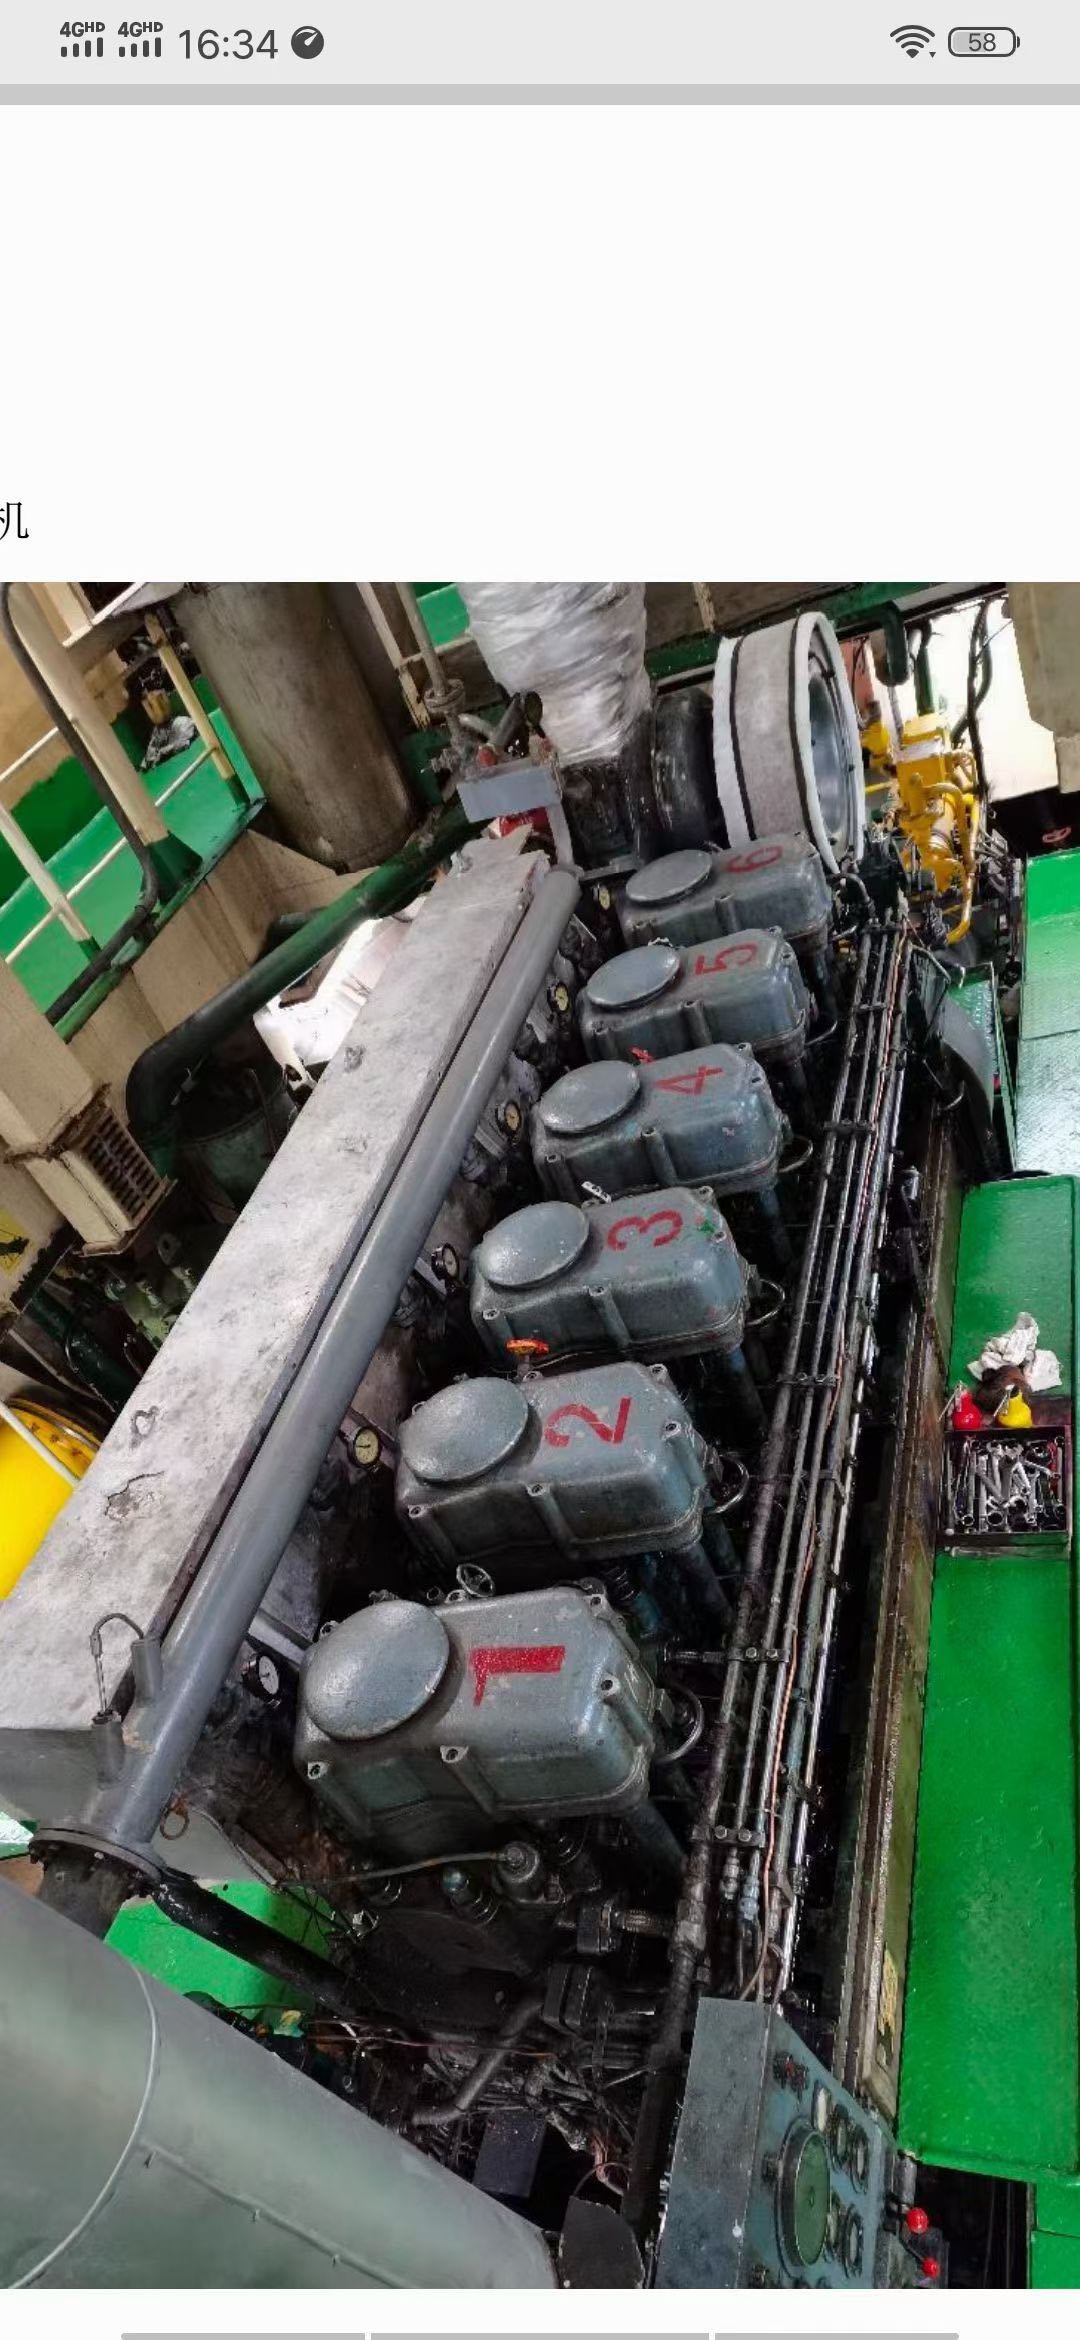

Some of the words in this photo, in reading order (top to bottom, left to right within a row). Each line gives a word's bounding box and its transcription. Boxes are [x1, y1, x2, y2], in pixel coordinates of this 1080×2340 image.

[694, 943, 758, 976] 5
[655, 1065, 724, 1096] 4
[607, 1209, 684, 1251] 3
[544, 1396, 633, 1448] 2
[471, 1644, 567, 1707] 1
